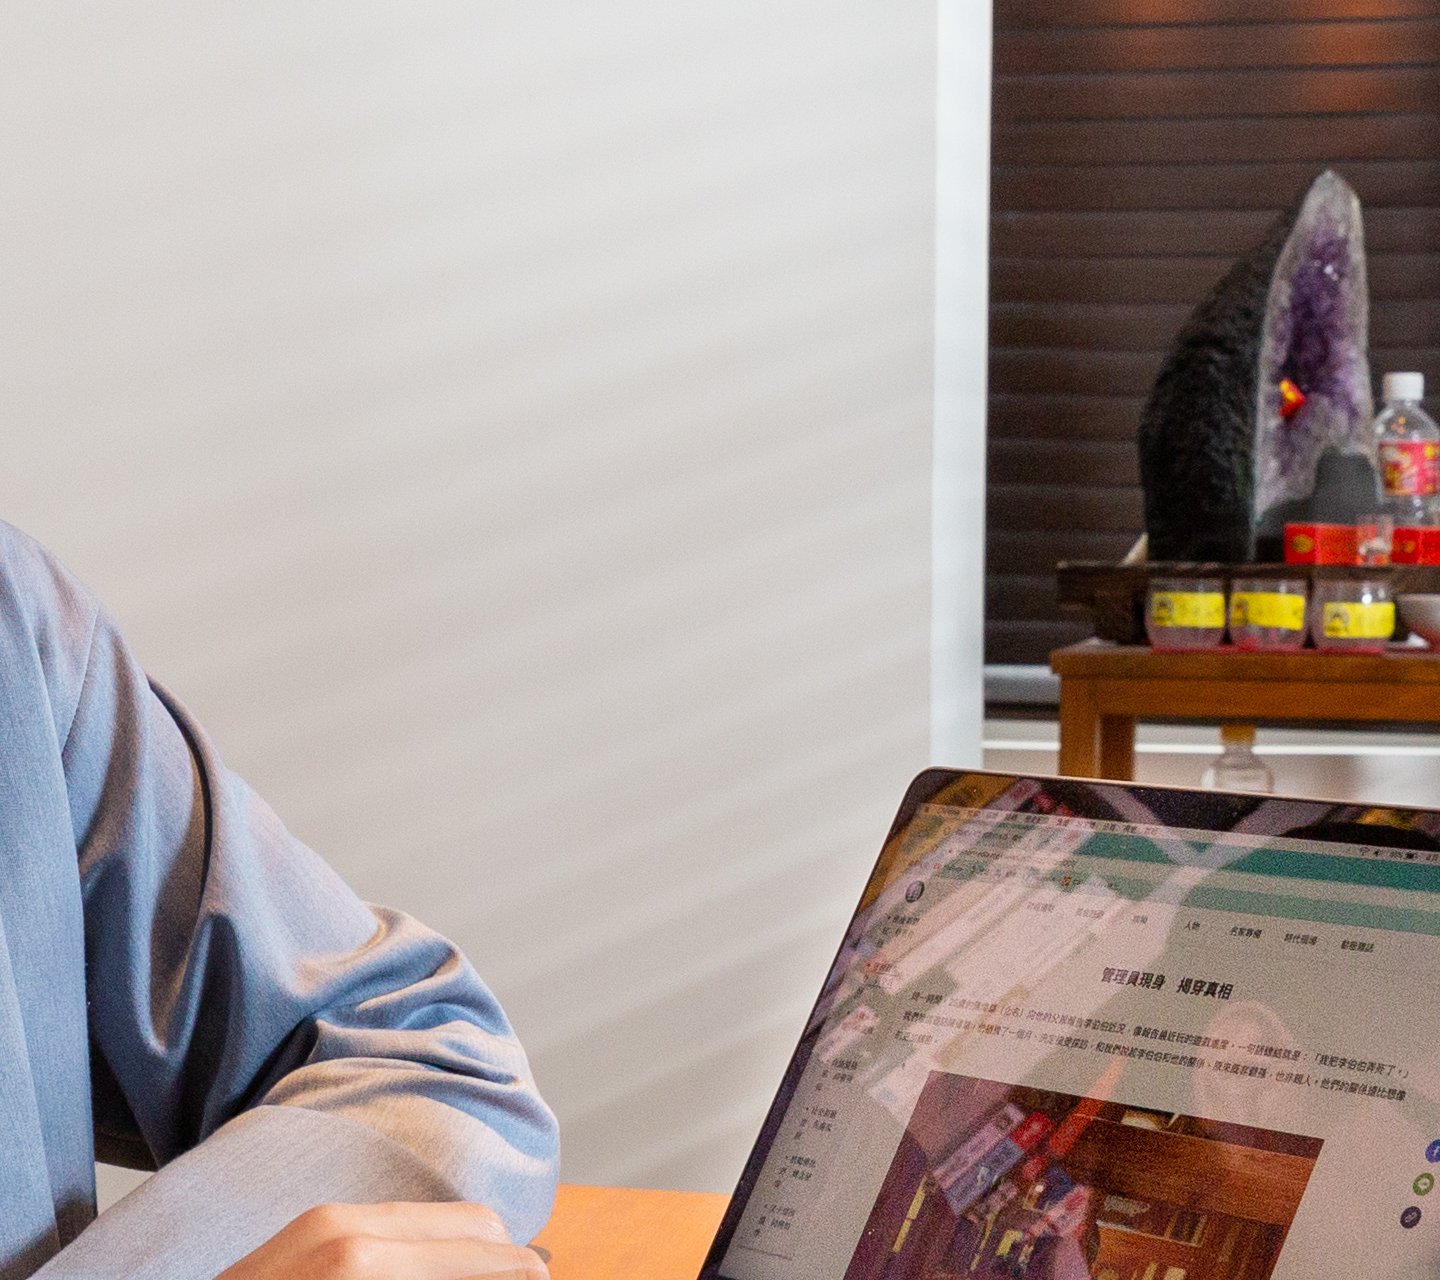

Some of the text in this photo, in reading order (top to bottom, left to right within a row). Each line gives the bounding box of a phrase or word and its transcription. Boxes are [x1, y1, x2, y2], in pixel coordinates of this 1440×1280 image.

[1184, 919, 1201, 932] 人物
[1229, 925, 1263, 940] 名家專欄
[1283, 932, 1319, 947] 時代現場
[1100, 966, 1235, 1001] 管理員現身 揭穿真相
